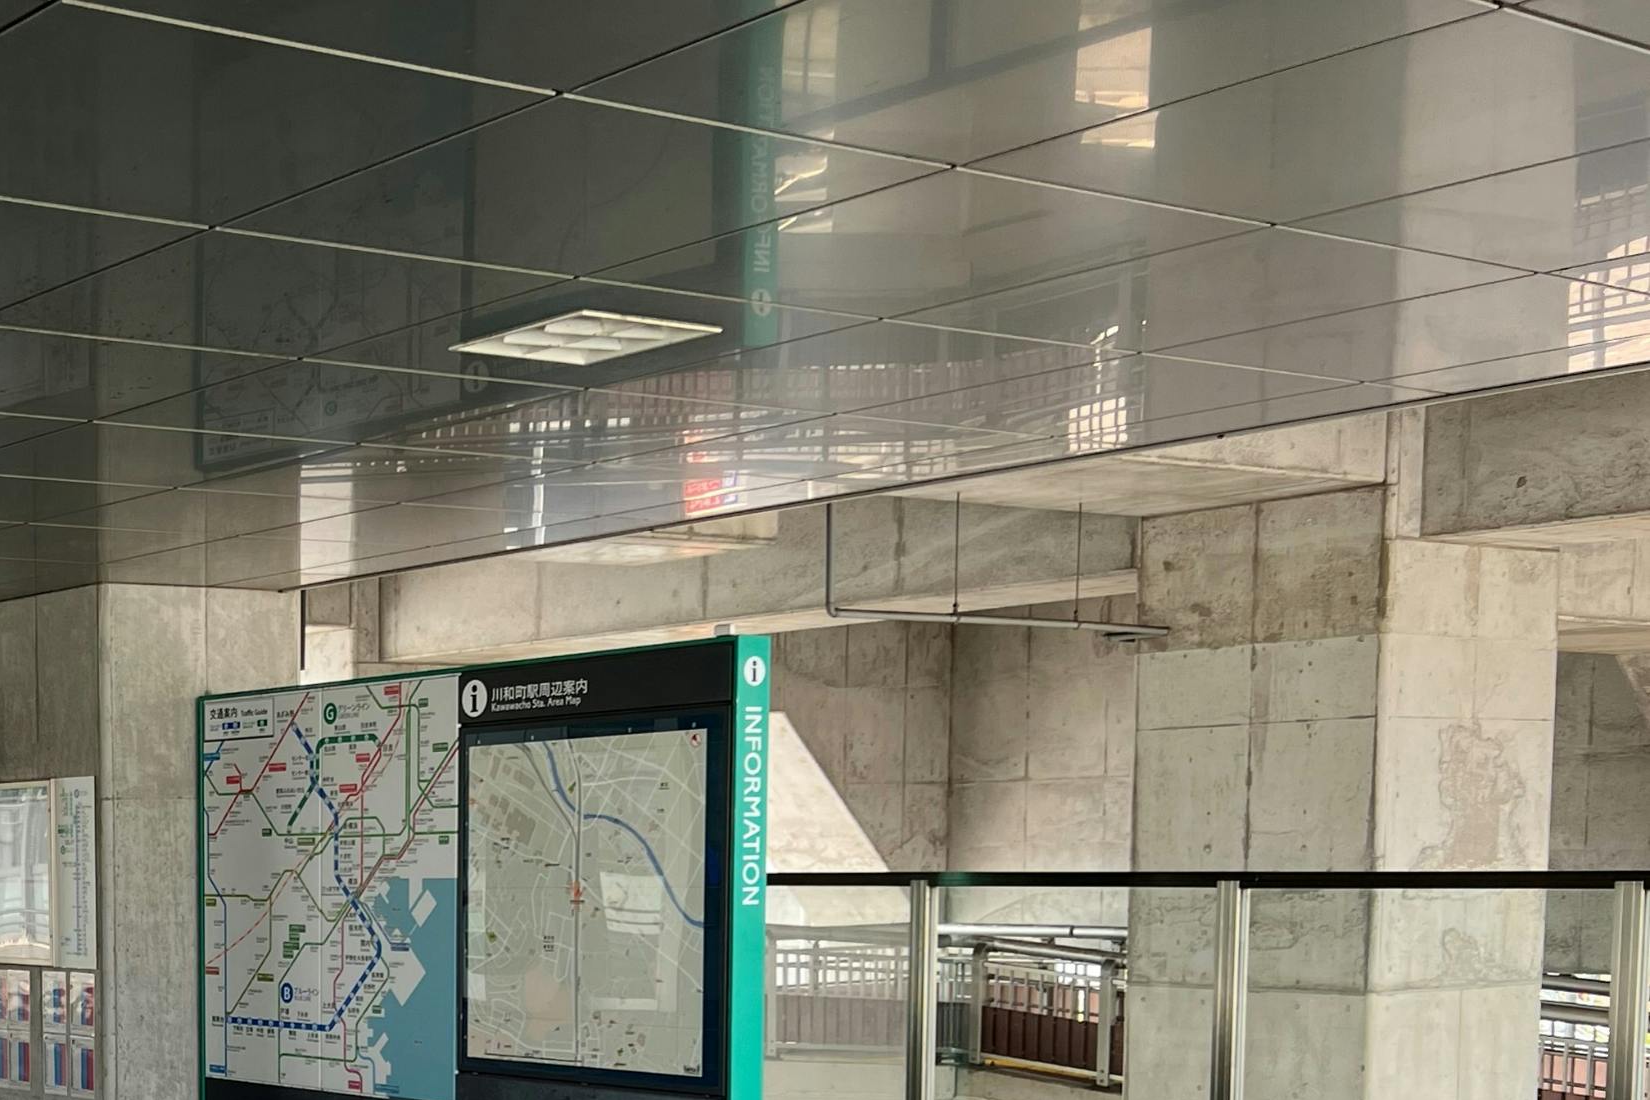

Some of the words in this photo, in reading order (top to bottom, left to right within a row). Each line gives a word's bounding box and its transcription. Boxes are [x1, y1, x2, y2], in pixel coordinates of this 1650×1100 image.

[491, 678, 589, 702] 川和町駅周辺案内
[546, 697, 564, 708] Area
[565, 695, 582, 707] Map
[209, 707, 238, 720] 交通案内
[741, 706, 763, 906] INFORMATION
